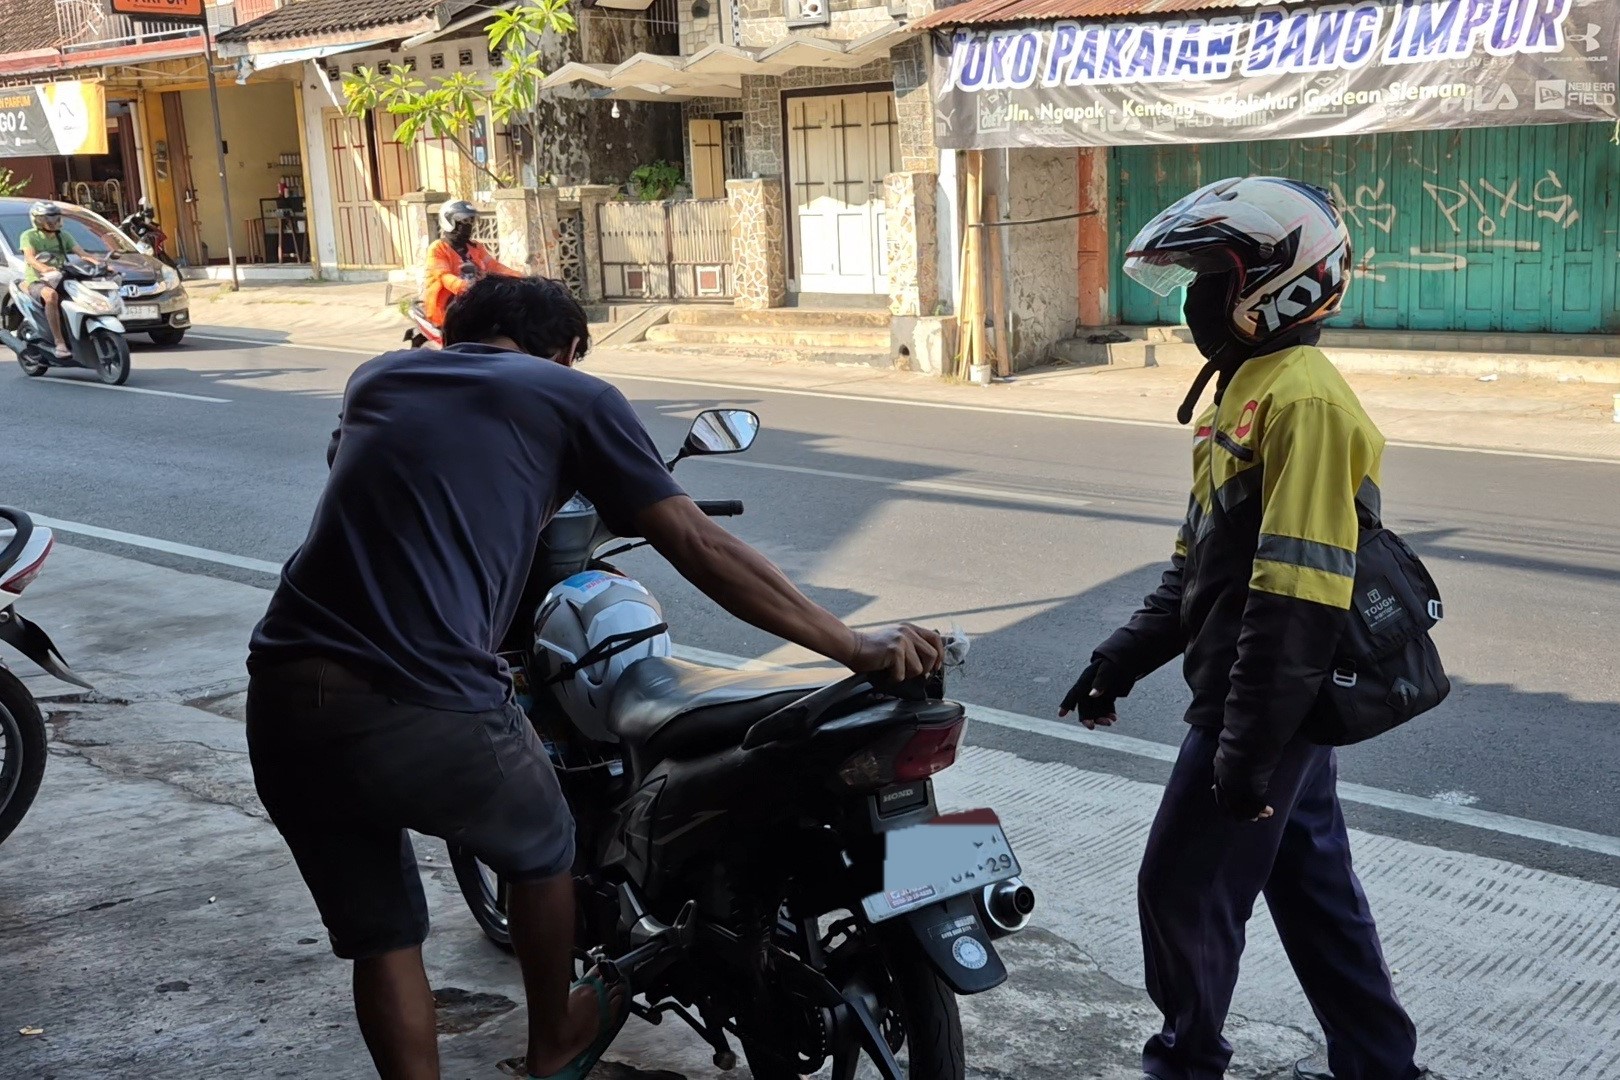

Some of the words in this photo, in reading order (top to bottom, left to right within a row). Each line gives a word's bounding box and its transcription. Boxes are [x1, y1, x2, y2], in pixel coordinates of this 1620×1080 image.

[1044, 20, 1238, 84] PAKAIAN
[1246, 6, 1381, 73] BANG
[1385, 0, 1570, 61] IMPUR
[1567, 82, 1592, 92] NEW
[1593, 81, 1616, 92] ERA
[1004, 103, 1034, 122] Jln.
[1039, 100, 1104, 124] Ngapak
[1122, 98, 1196, 120] Kenteng
[1388, 81, 1466, 102] Sleman
[1567, 92, 1616, 107] FIELD
[17, 110, 28, 131] 2
[1363, 594, 1396, 617] TOUGH
